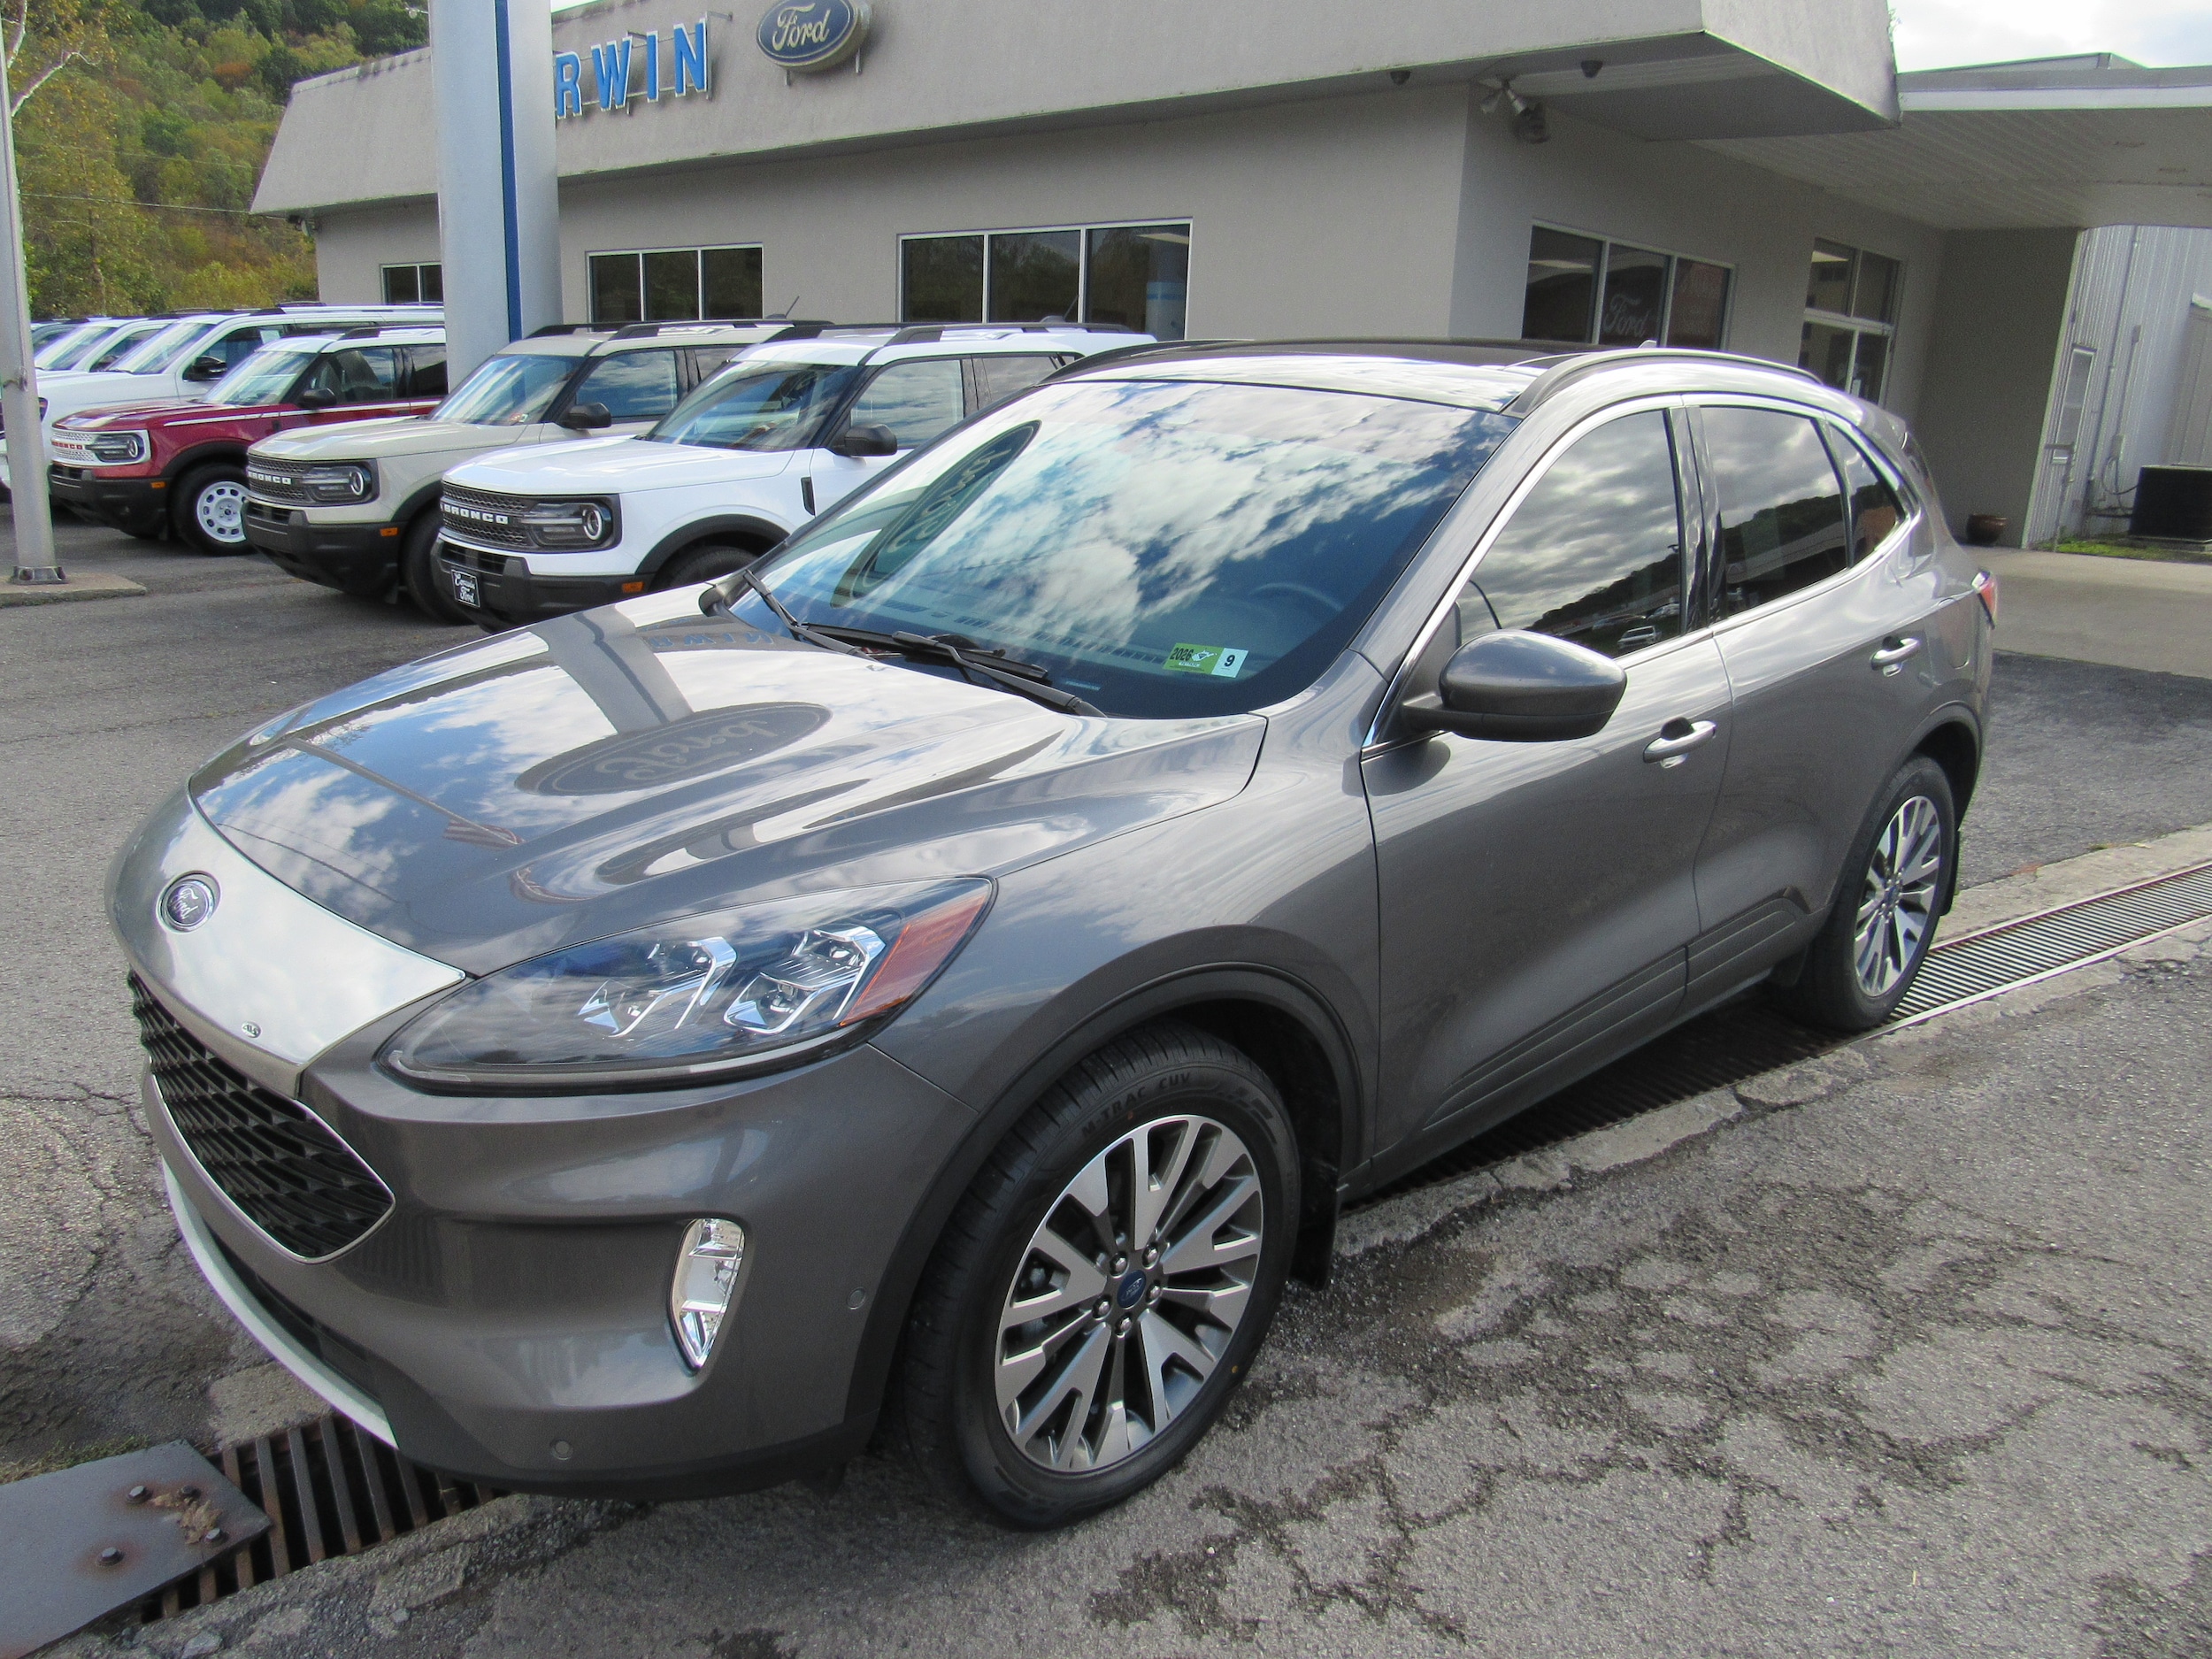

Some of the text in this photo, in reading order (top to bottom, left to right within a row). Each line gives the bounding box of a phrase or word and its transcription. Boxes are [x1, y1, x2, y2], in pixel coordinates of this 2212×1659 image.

[772, 3, 832, 51] Ford
[555, 18, 707, 119] RWIN
[1602, 294, 1651, 337] Ford
[247, 471, 291, 485] BRONCO
[443, 503, 509, 525] BRONCO
[1169, 648, 1236, 667] 2026 9
[169, 887, 199, 920] Ford
[1081, 1072, 1191, 1138] M-TRAC CUV
